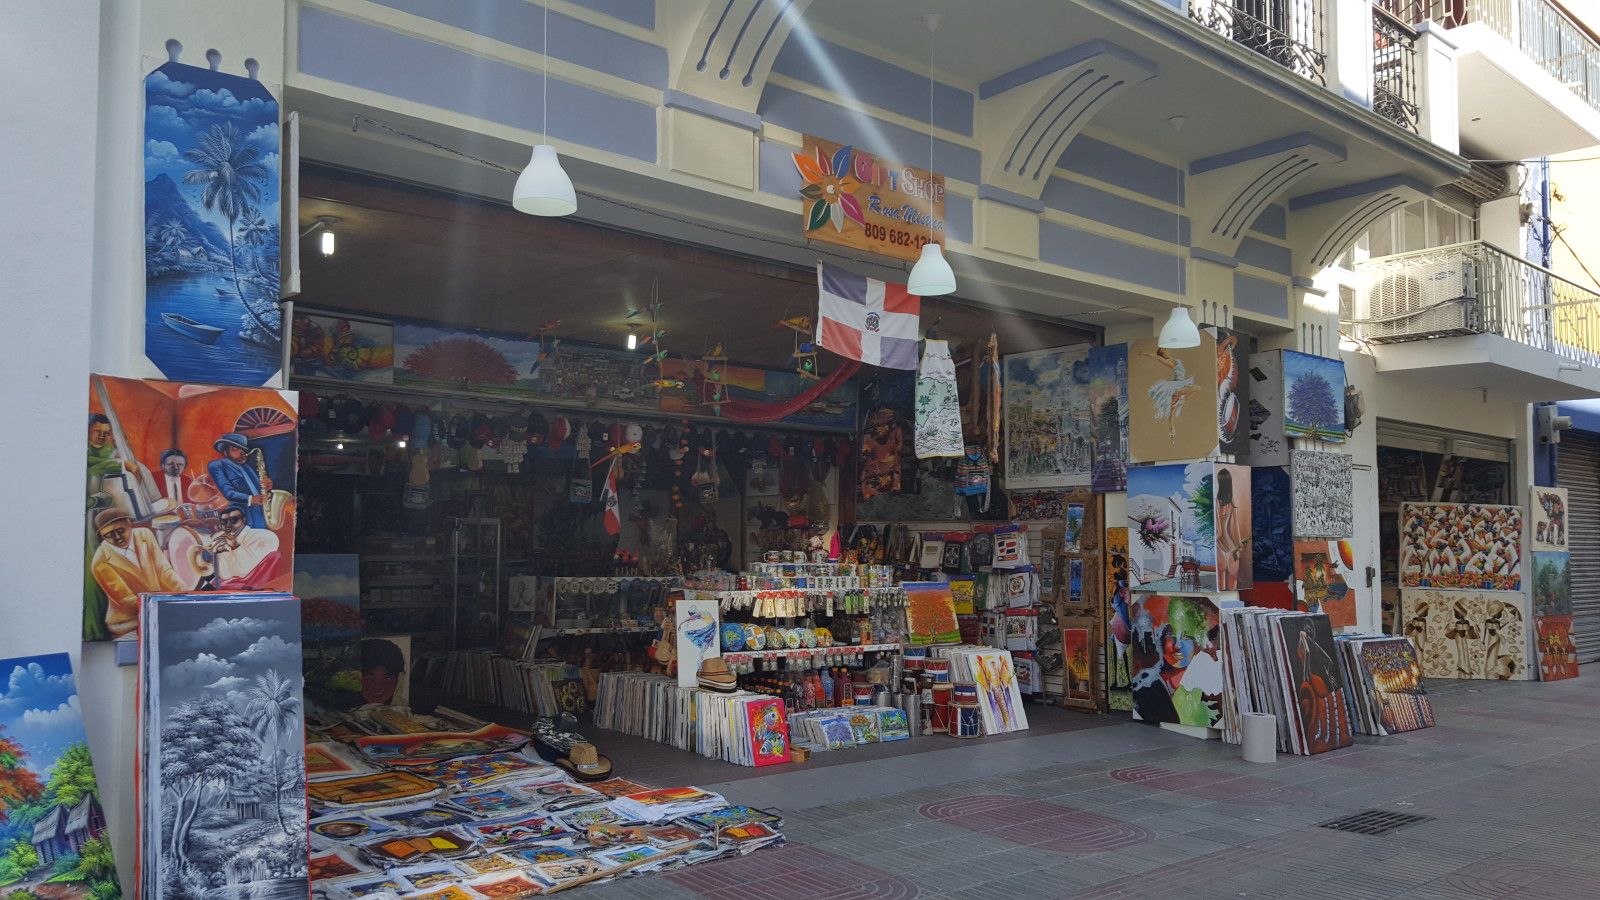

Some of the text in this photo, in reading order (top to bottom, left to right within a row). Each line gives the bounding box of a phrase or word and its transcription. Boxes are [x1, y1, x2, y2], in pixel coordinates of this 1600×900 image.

[902, 167, 945, 202] SHOP
[867, 195, 900, 219] Rosa
[864, 222, 941, 250] 809 682-12
